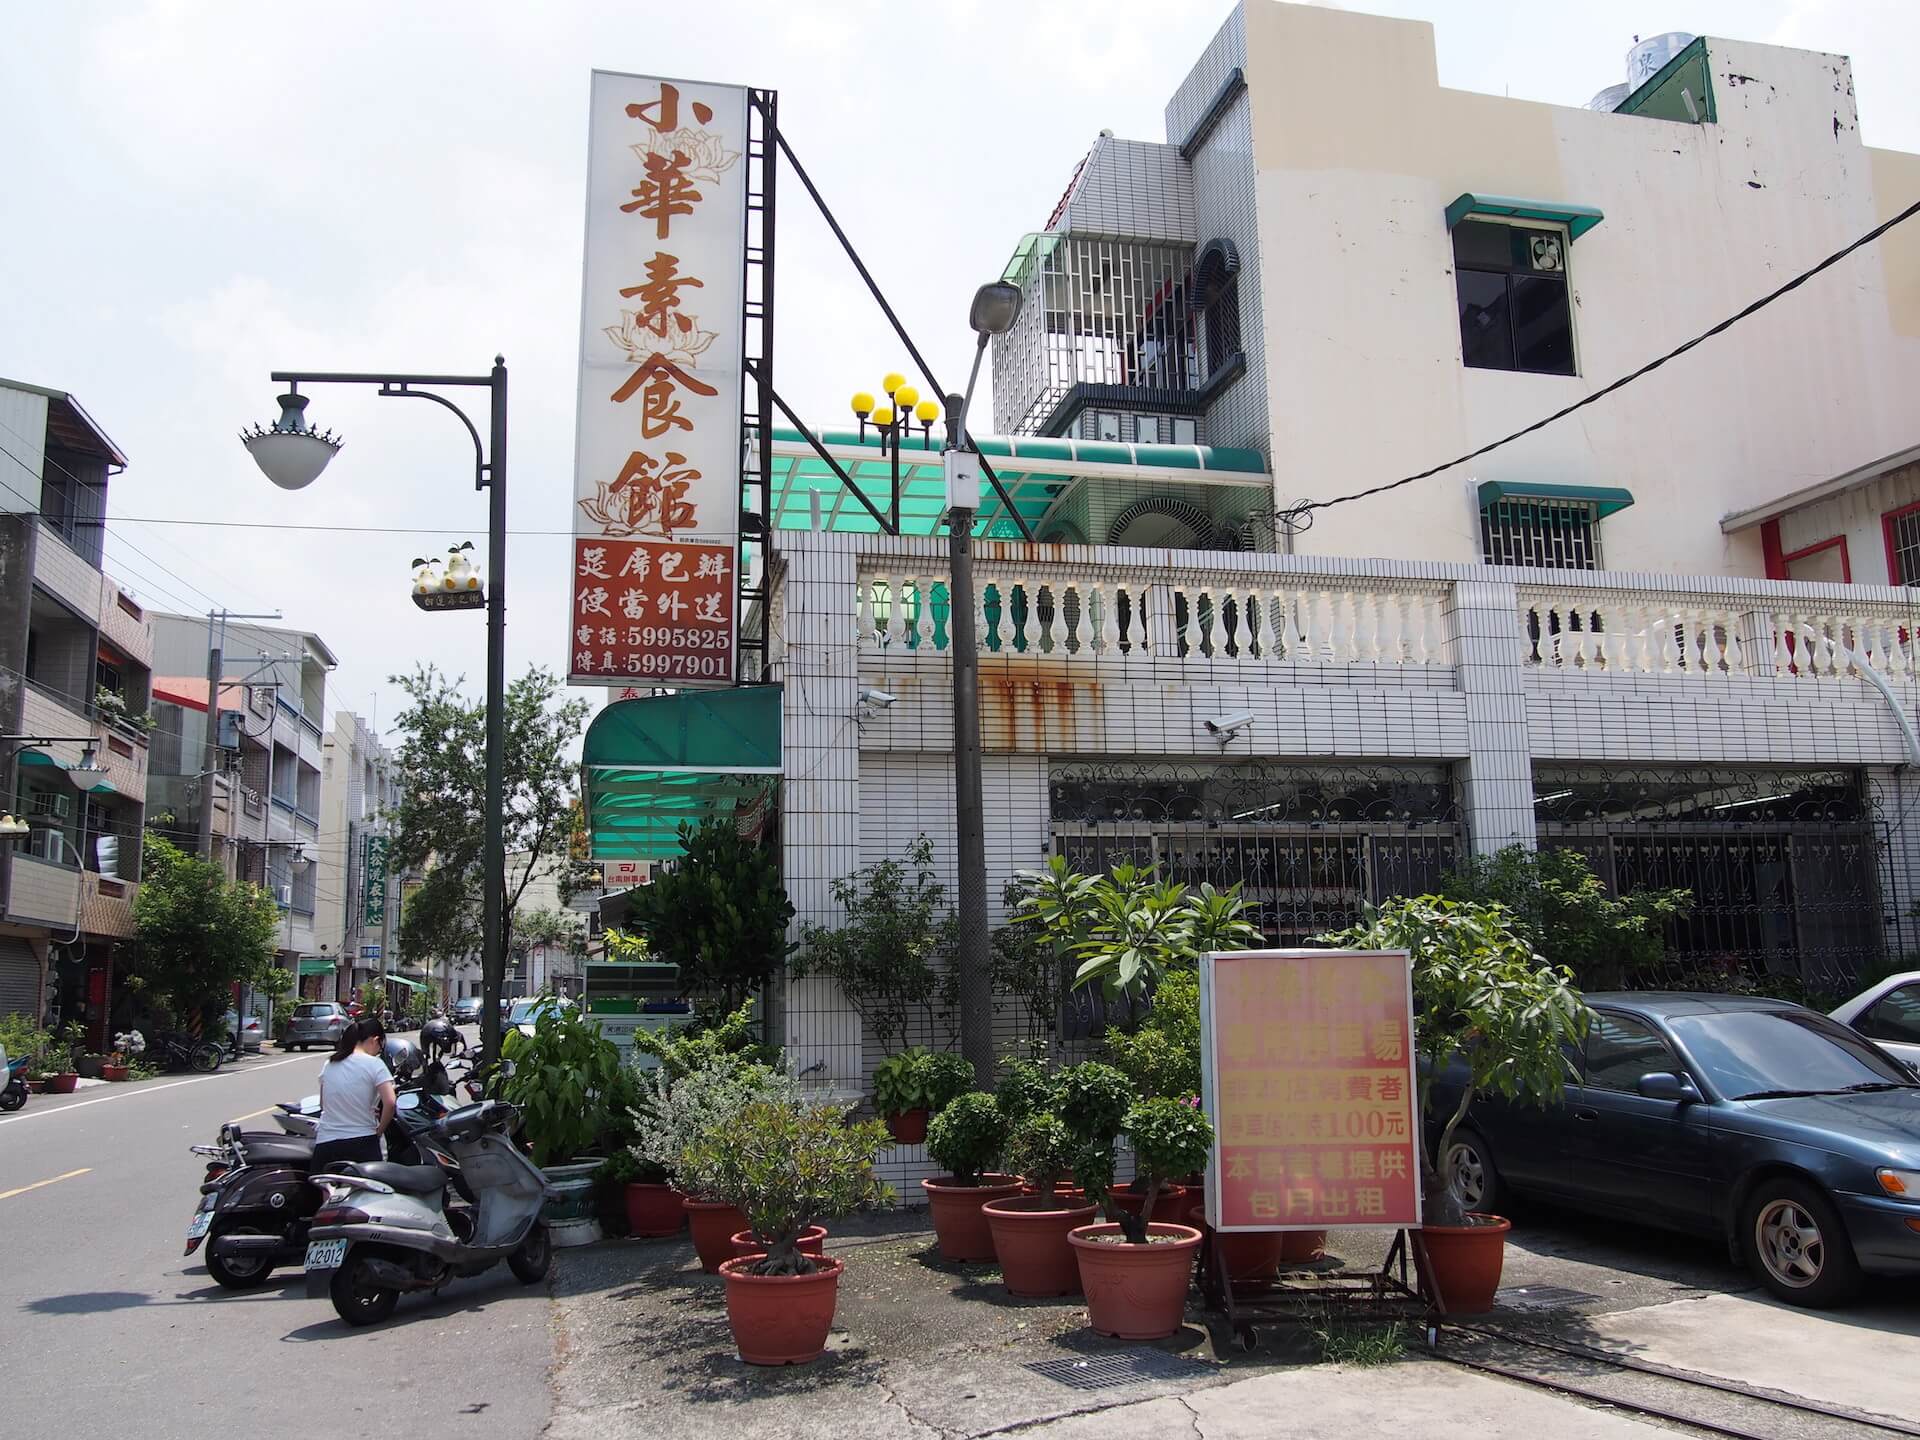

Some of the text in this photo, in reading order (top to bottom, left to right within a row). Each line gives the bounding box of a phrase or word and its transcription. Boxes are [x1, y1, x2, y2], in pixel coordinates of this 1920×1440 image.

[610, 82, 718, 541] 小華素食館
[577, 586, 730, 623] 便當外送
[1248, 1187, 1386, 1218] 包月出租
